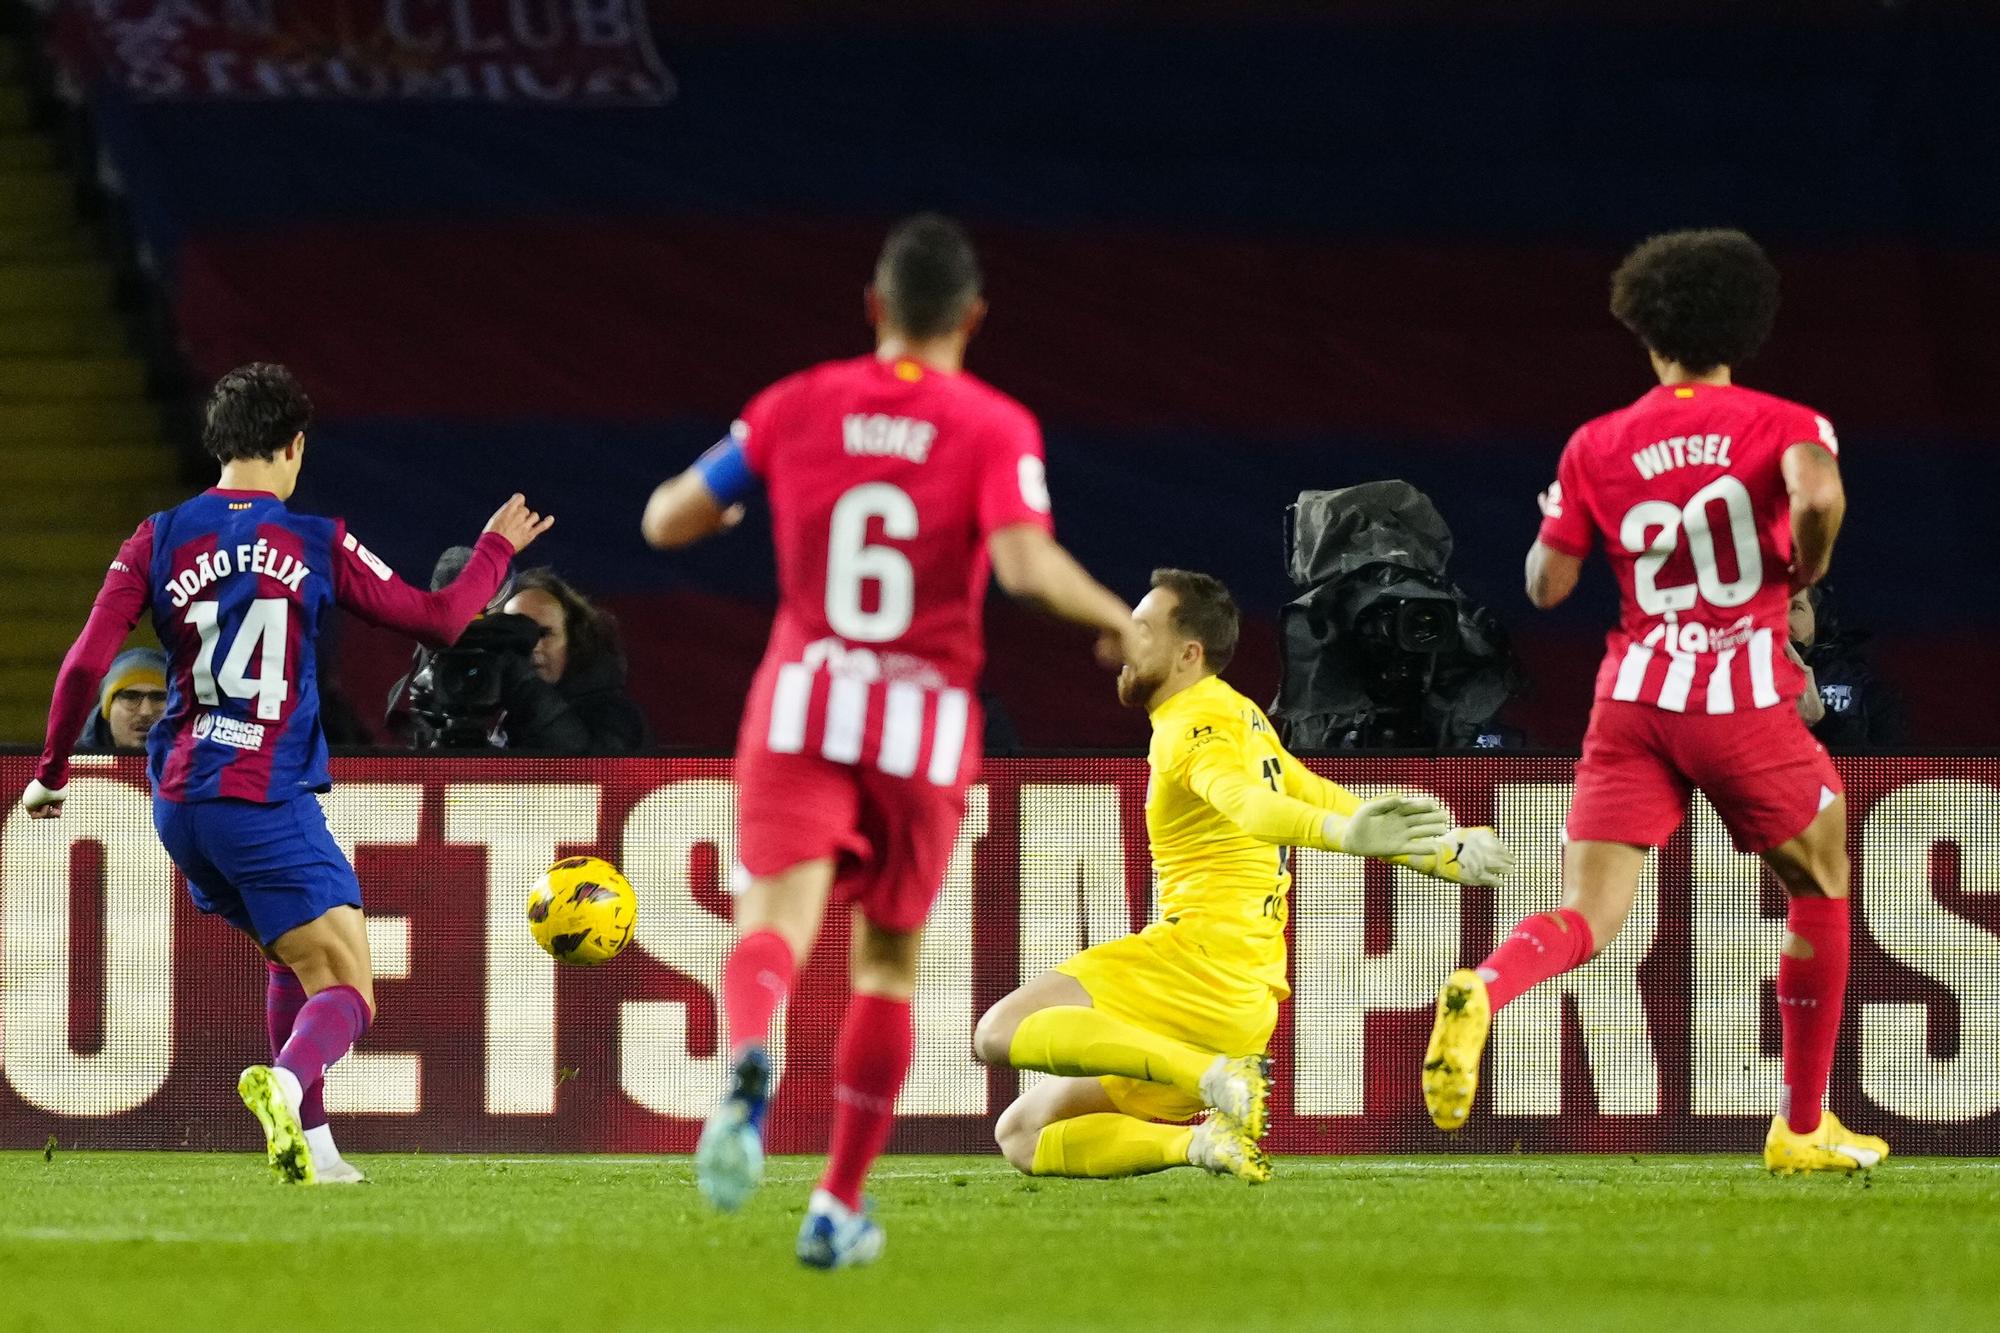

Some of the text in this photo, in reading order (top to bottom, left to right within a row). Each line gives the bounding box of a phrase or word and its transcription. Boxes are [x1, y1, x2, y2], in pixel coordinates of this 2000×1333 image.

[384, 0, 632, 50] CLUB
[1632, 434, 1732, 480] WITSEL
[164, 549, 232, 608] JOÃO
[236, 538, 311, 593] FÉLIX
[825, 481, 919, 643] 6
[1620, 475, 1763, 616] 20
[183, 598, 289, 721] 14
[215, 715, 265, 738] UNHCR
